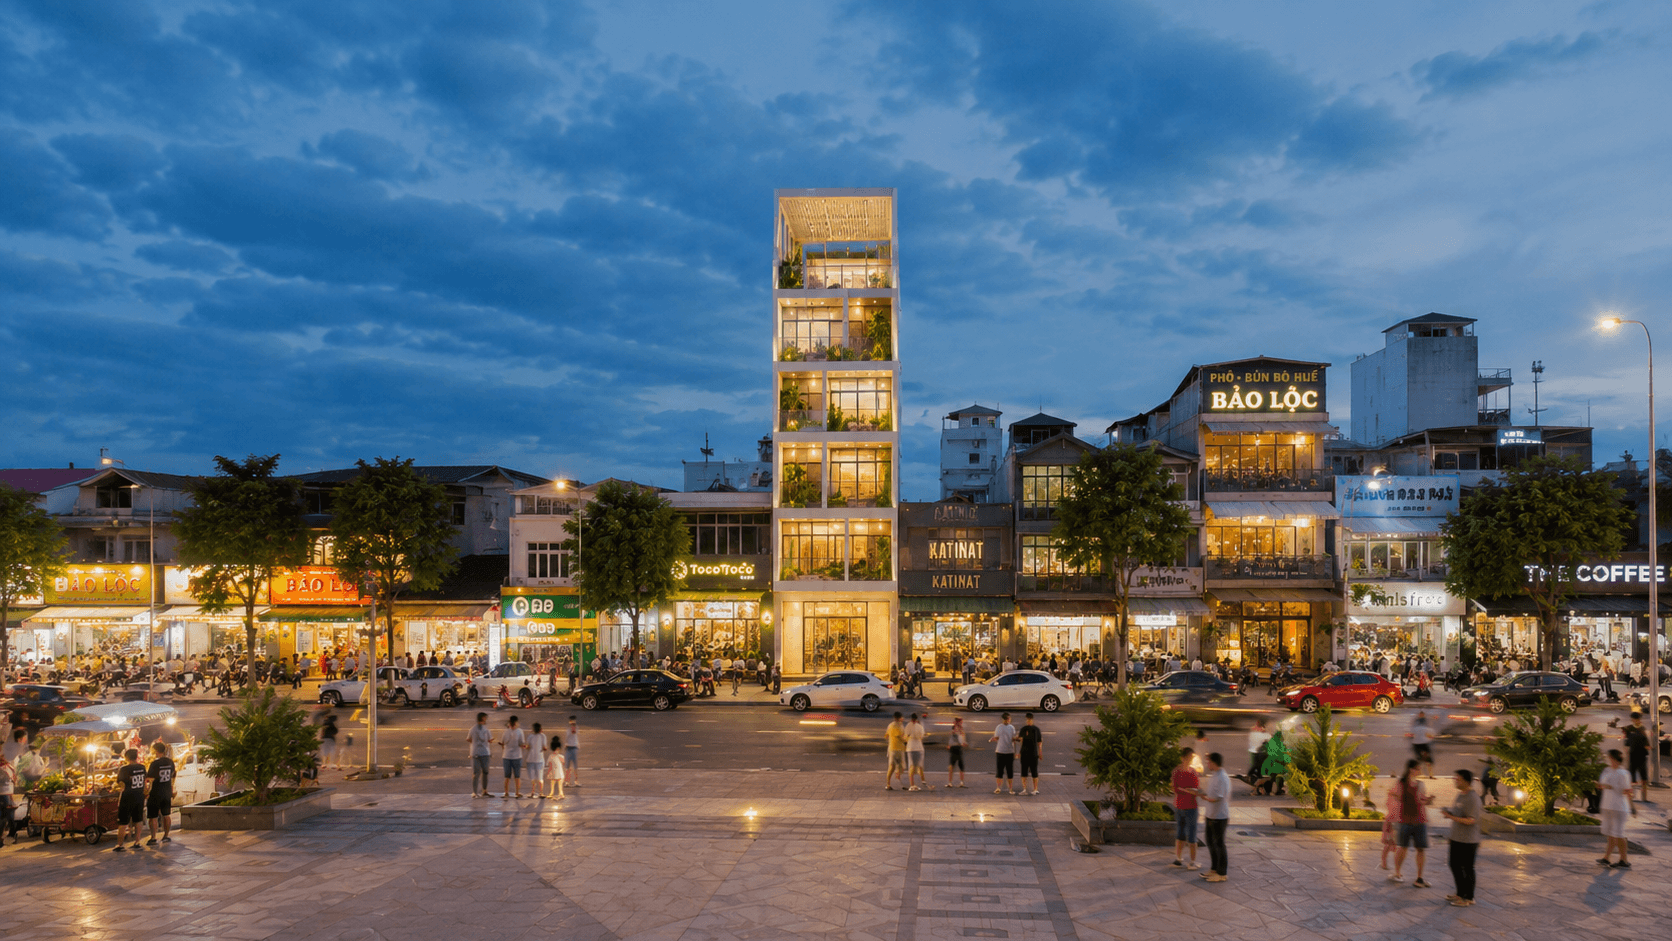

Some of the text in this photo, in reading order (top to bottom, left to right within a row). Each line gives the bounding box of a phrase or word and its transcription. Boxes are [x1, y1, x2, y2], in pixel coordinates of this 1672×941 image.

[1211, 385, 1317, 412] BẢO LỘC
[929, 541, 983, 559] KATINAT
[932, 575, 980, 588] KATINAT
[1576, 565, 1664, 582] COFFEE
